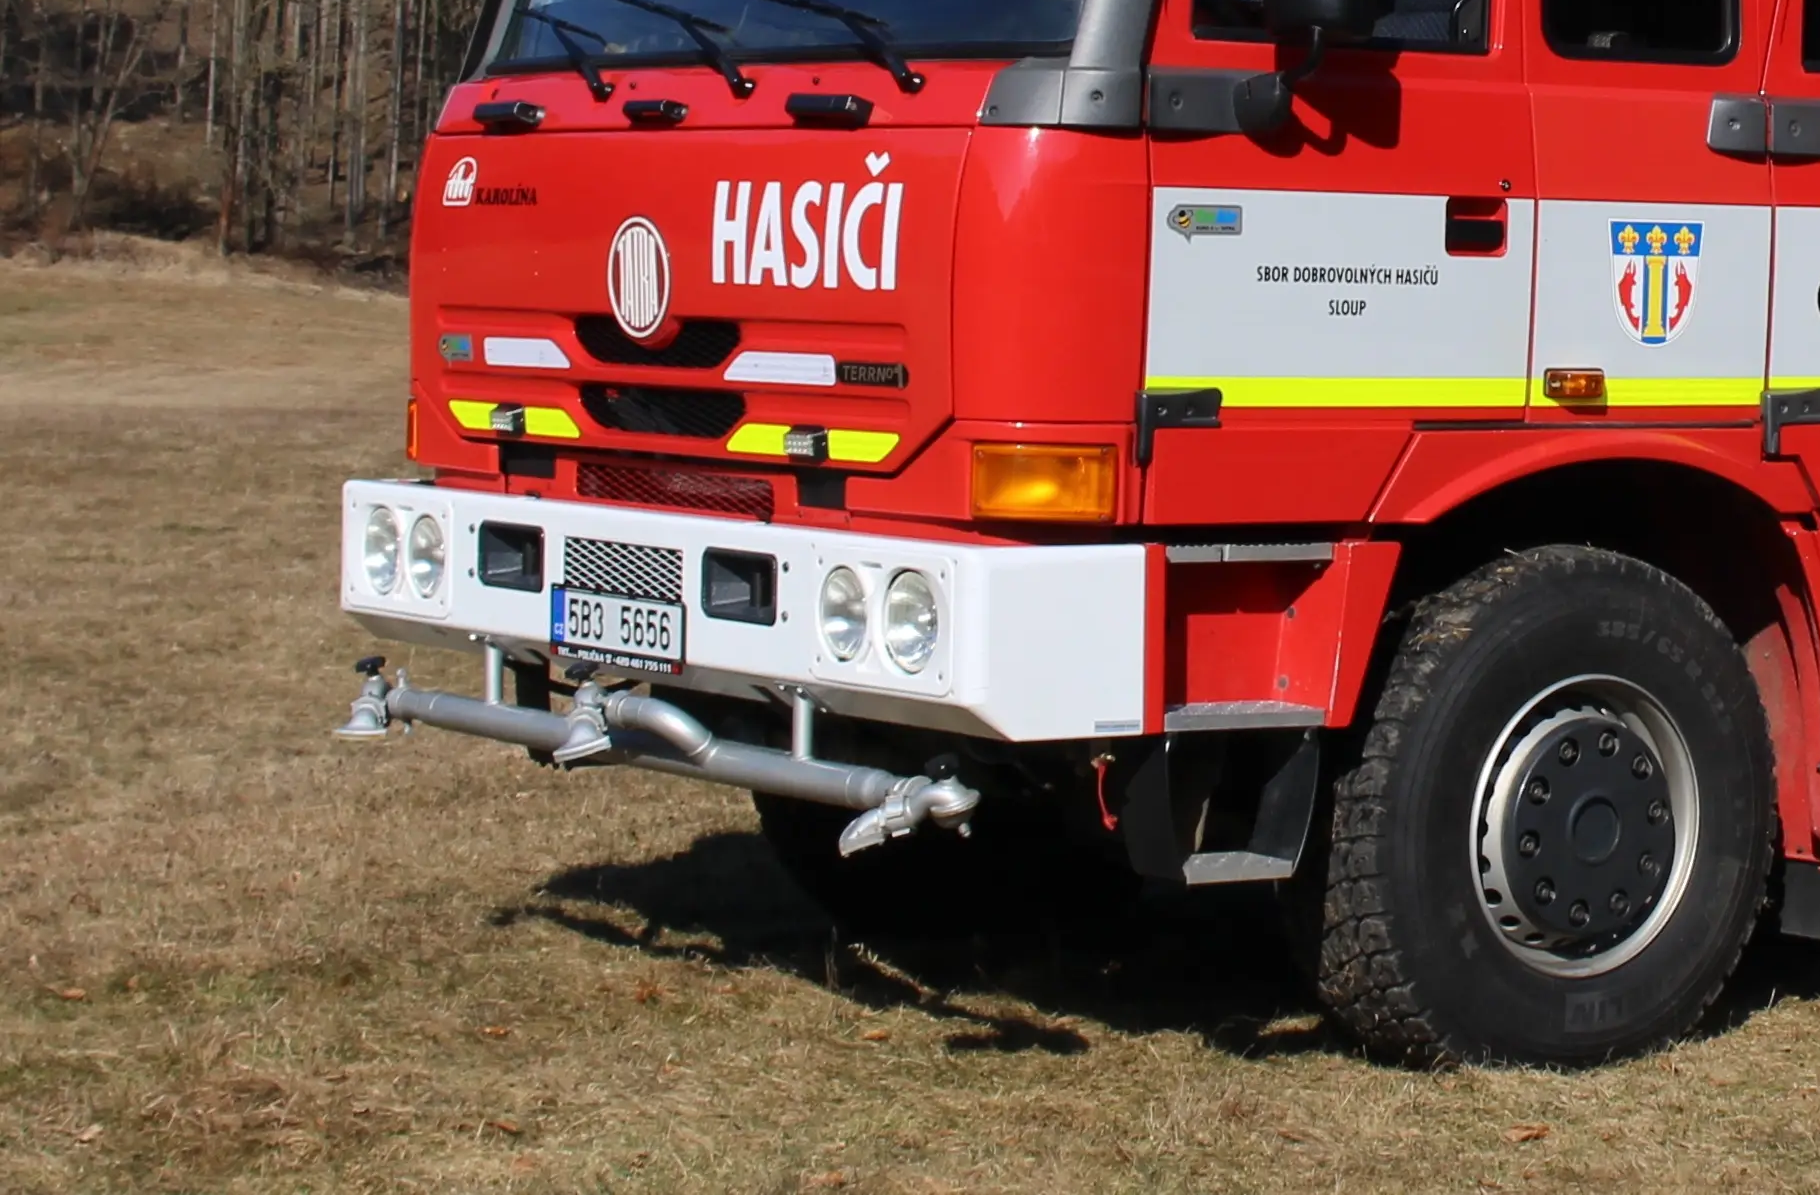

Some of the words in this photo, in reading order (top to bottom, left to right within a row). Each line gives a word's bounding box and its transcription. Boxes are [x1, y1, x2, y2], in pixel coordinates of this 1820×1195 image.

[475, 182, 538, 206] KAROLÍNA
[712, 151, 904, 291] HASIČI
[617, 226, 659, 328] TATRA
[1256, 265, 1289, 283] SBOR
[1293, 263, 1392, 285] DOBROVOLNÝCH
[1395, 265, 1440, 286] HASIČŮ
[1328, 299, 1367, 317] SLOUP
[553, 622, 564, 635] CZ
[568, 597, 605, 641] 5B3
[620, 605, 672, 651] 5656
